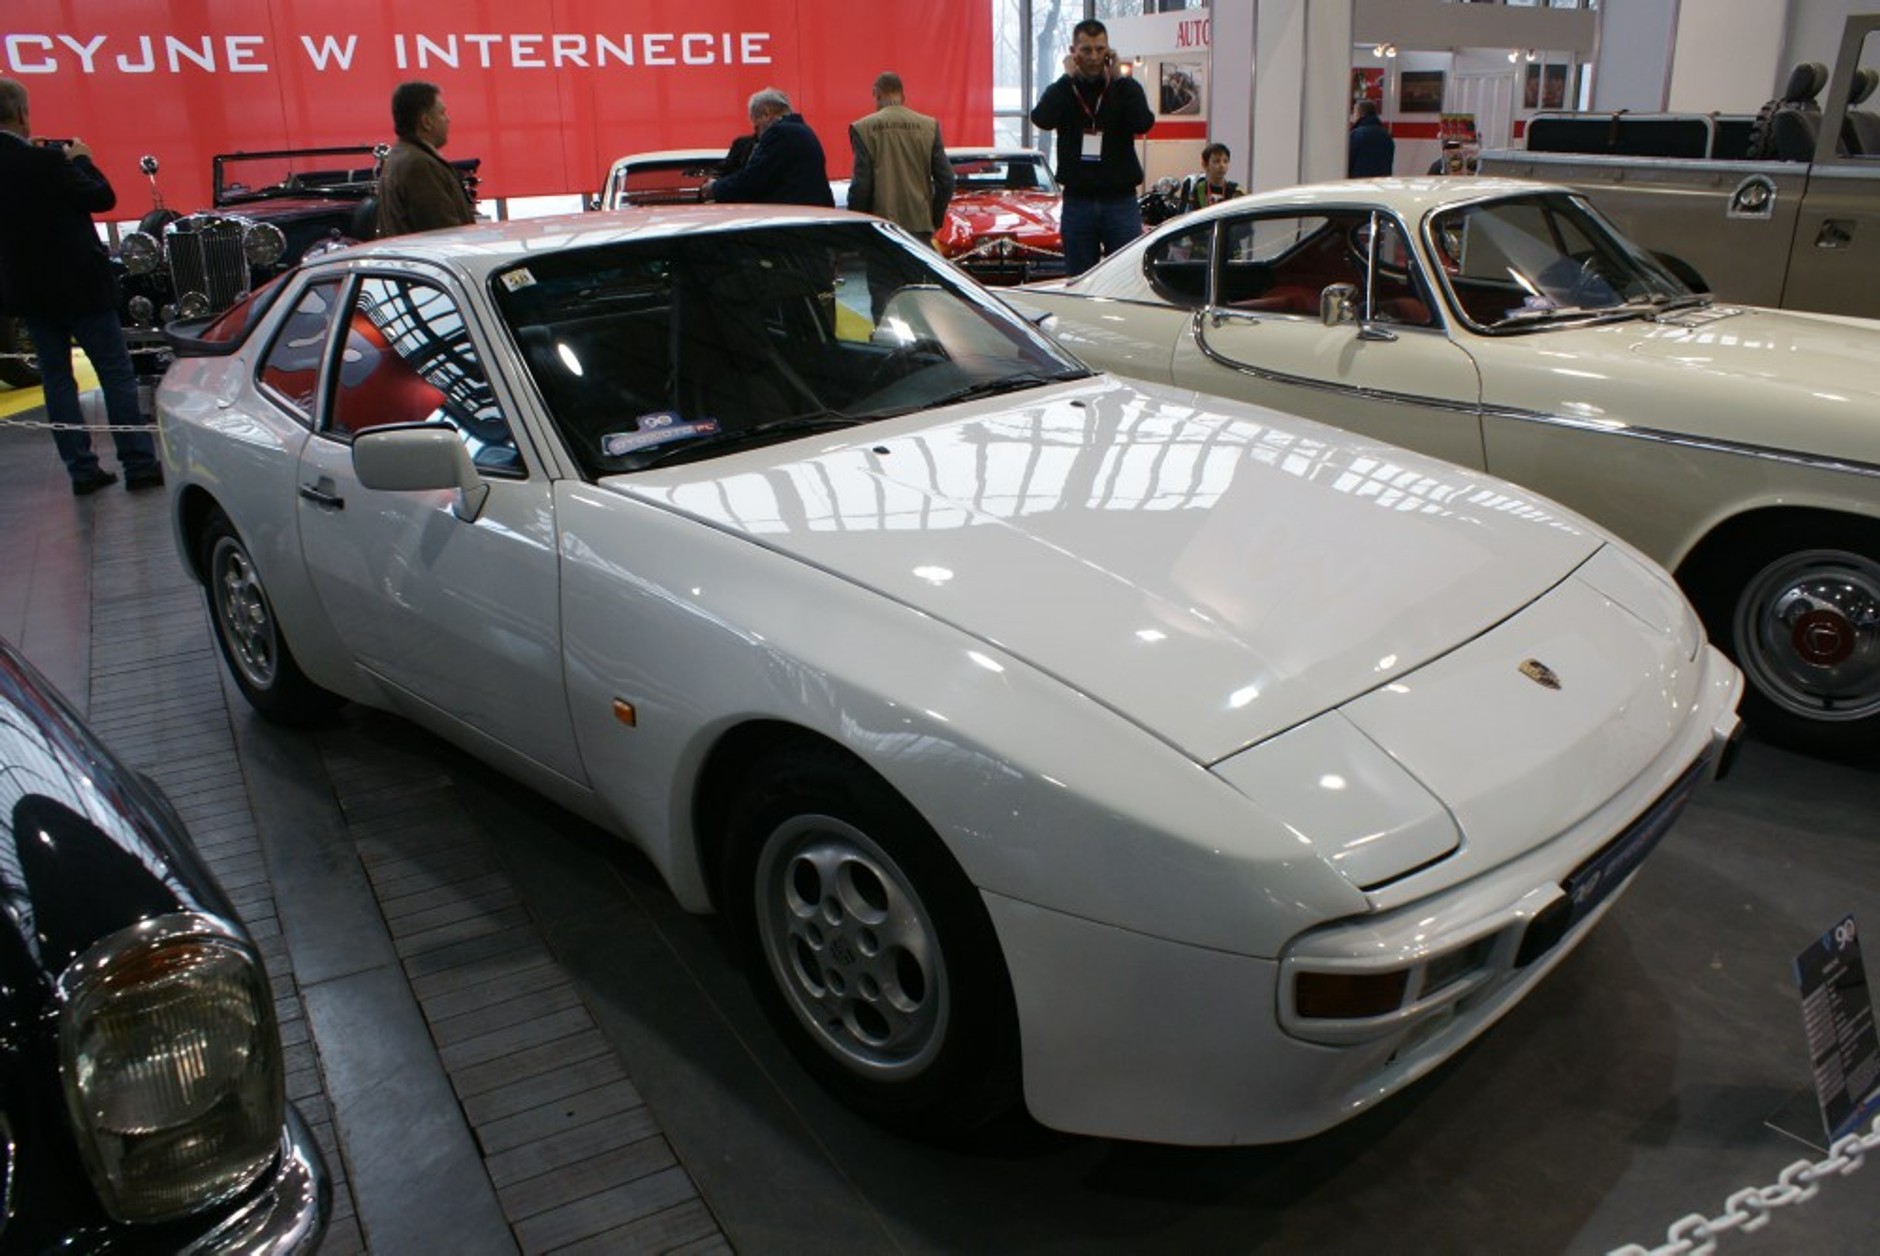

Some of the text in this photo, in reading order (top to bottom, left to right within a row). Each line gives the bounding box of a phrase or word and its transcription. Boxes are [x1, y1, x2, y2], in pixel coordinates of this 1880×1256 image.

[1175, 19, 1209, 48] AUTO
[0, 32, 772, 73] CYJNE W INTERNECIE
[1834, 918, 1855, 951] 90
